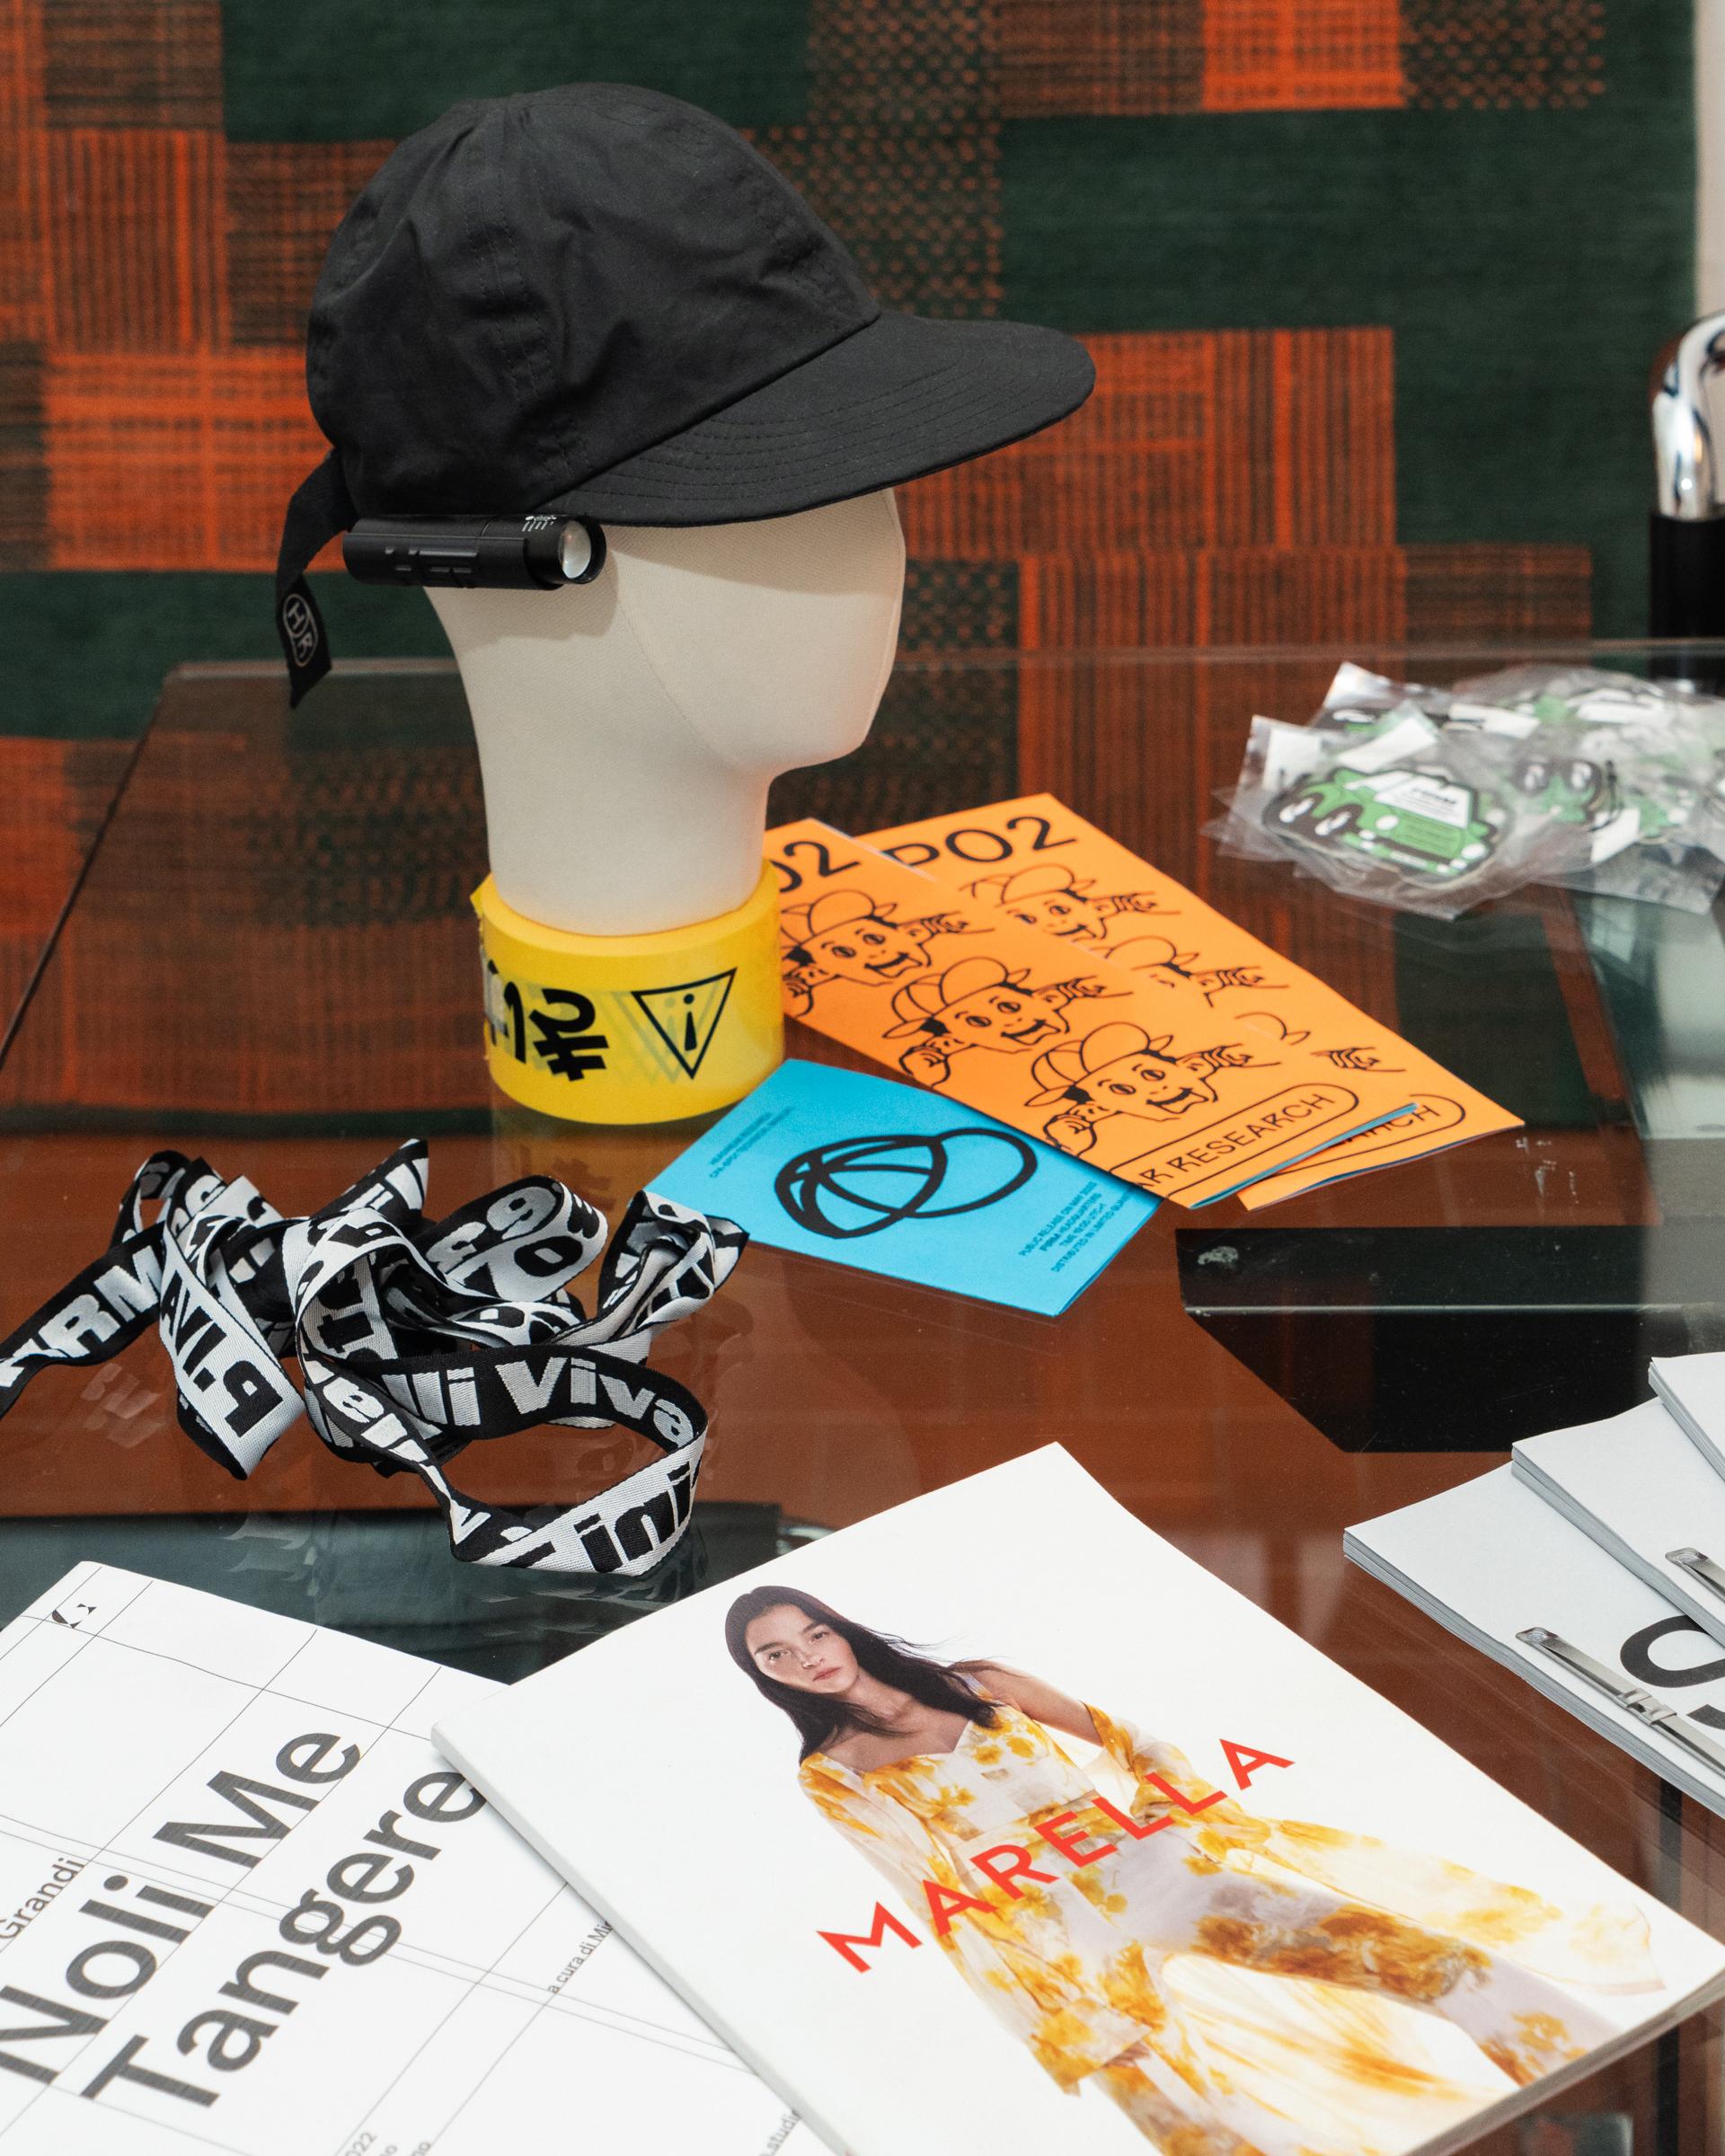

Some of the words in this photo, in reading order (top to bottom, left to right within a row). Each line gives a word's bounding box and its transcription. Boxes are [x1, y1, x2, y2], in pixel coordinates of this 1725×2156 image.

[1166, 1093, 1335, 1173] RESEARCH
[0, 1874, 217, 2085] Noli
[153, 1732, 362, 1869] Me
[79, 1771, 487, 2108] Tangere
[547, 1984, 561, 1994] a
[556, 1956, 585, 1984] cura
[578, 1940, 598, 1956] di
[816, 1737, 1296, 1973] MARELLA
